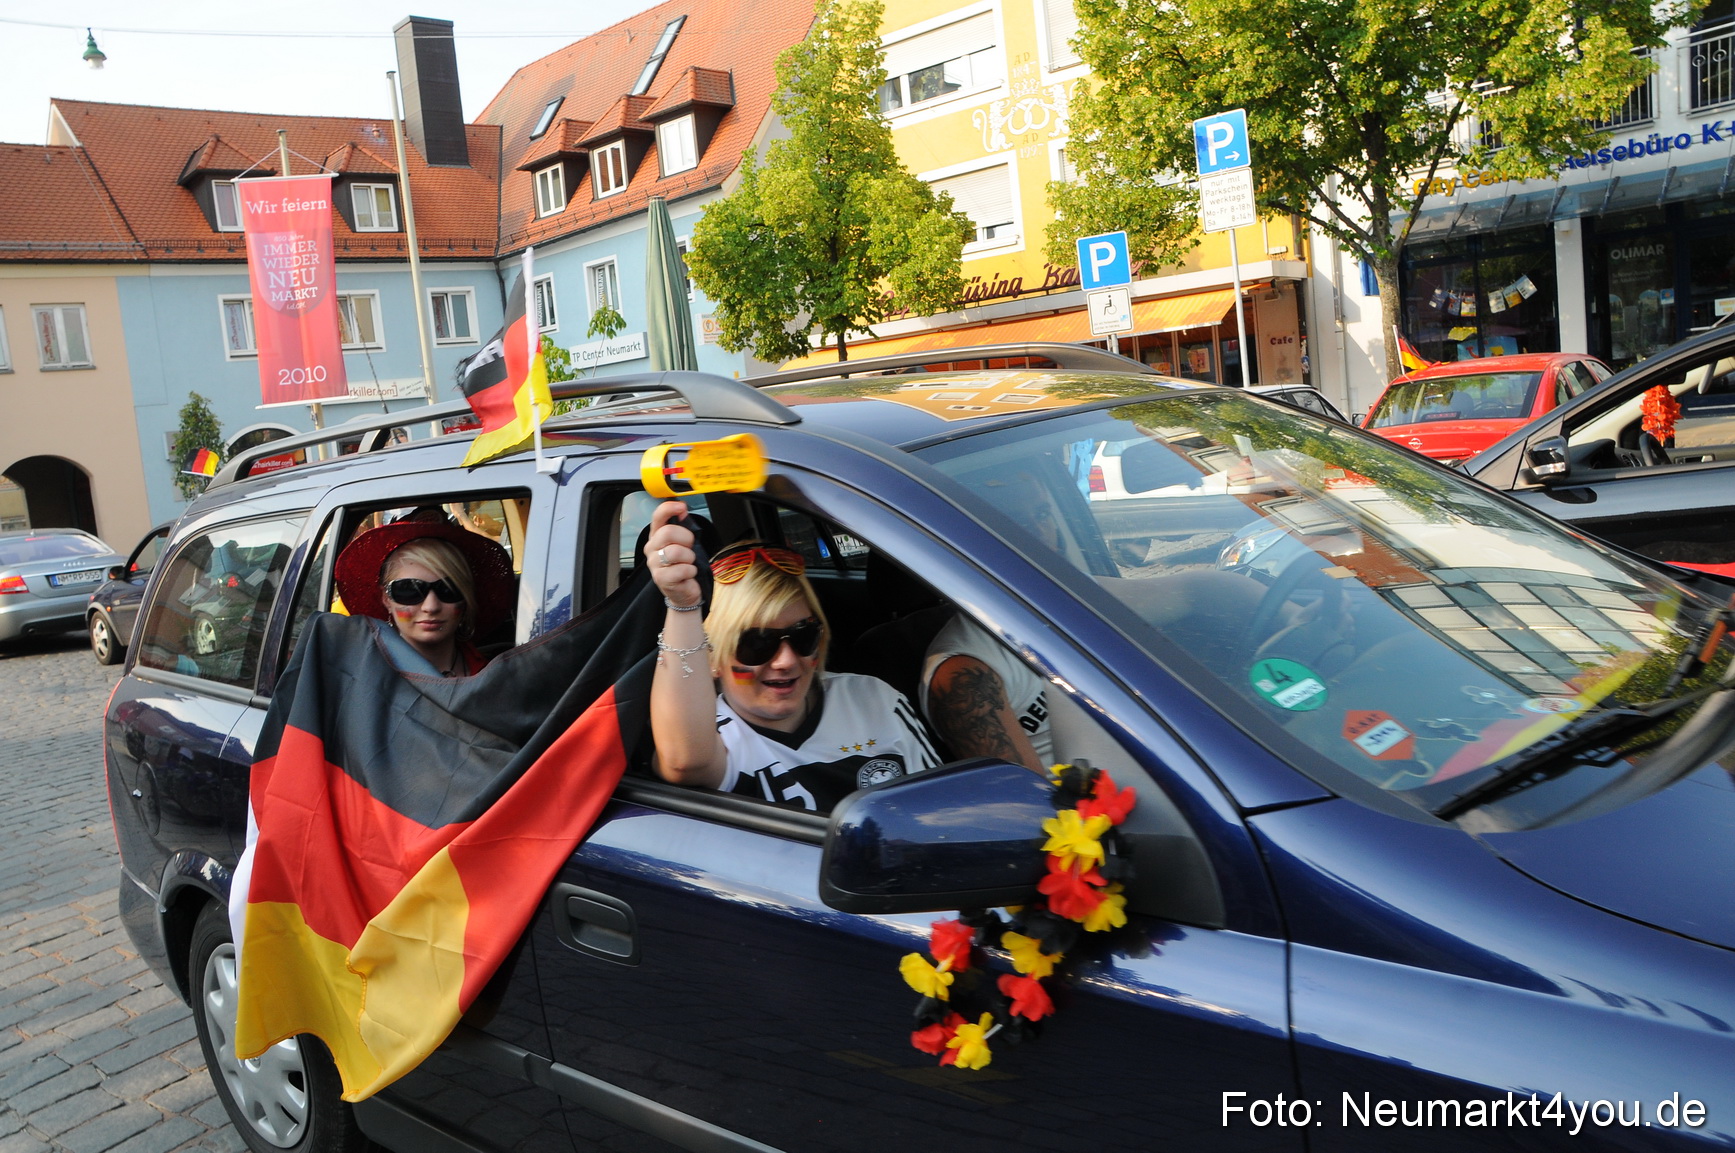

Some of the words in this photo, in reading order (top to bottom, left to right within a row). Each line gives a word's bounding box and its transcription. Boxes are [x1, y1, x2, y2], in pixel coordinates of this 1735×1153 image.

[1206, 121, 1234, 166] P
[1211, 178, 1223, 188] nur
[1228, 175, 1240, 183] mit
[1205, 184, 1248, 197] Parkschein
[246, 200, 277, 214] Wir
[282, 197, 327, 212] feiern
[1210, 193, 1245, 205] werktags
[264, 240, 317, 256] IMMER
[1610, 244, 1664, 260] OLIMAR
[262, 254, 320, 269] WIEDER
[1089, 241, 1116, 282] P
[268, 267, 316, 288] NEU
[272, 287, 318, 302] MARKT
[572, 352, 580, 363] TP
[582, 348, 604, 361] Center
[606, 342, 641, 357] Neumarkt
[278, 365, 327, 386] 2010
